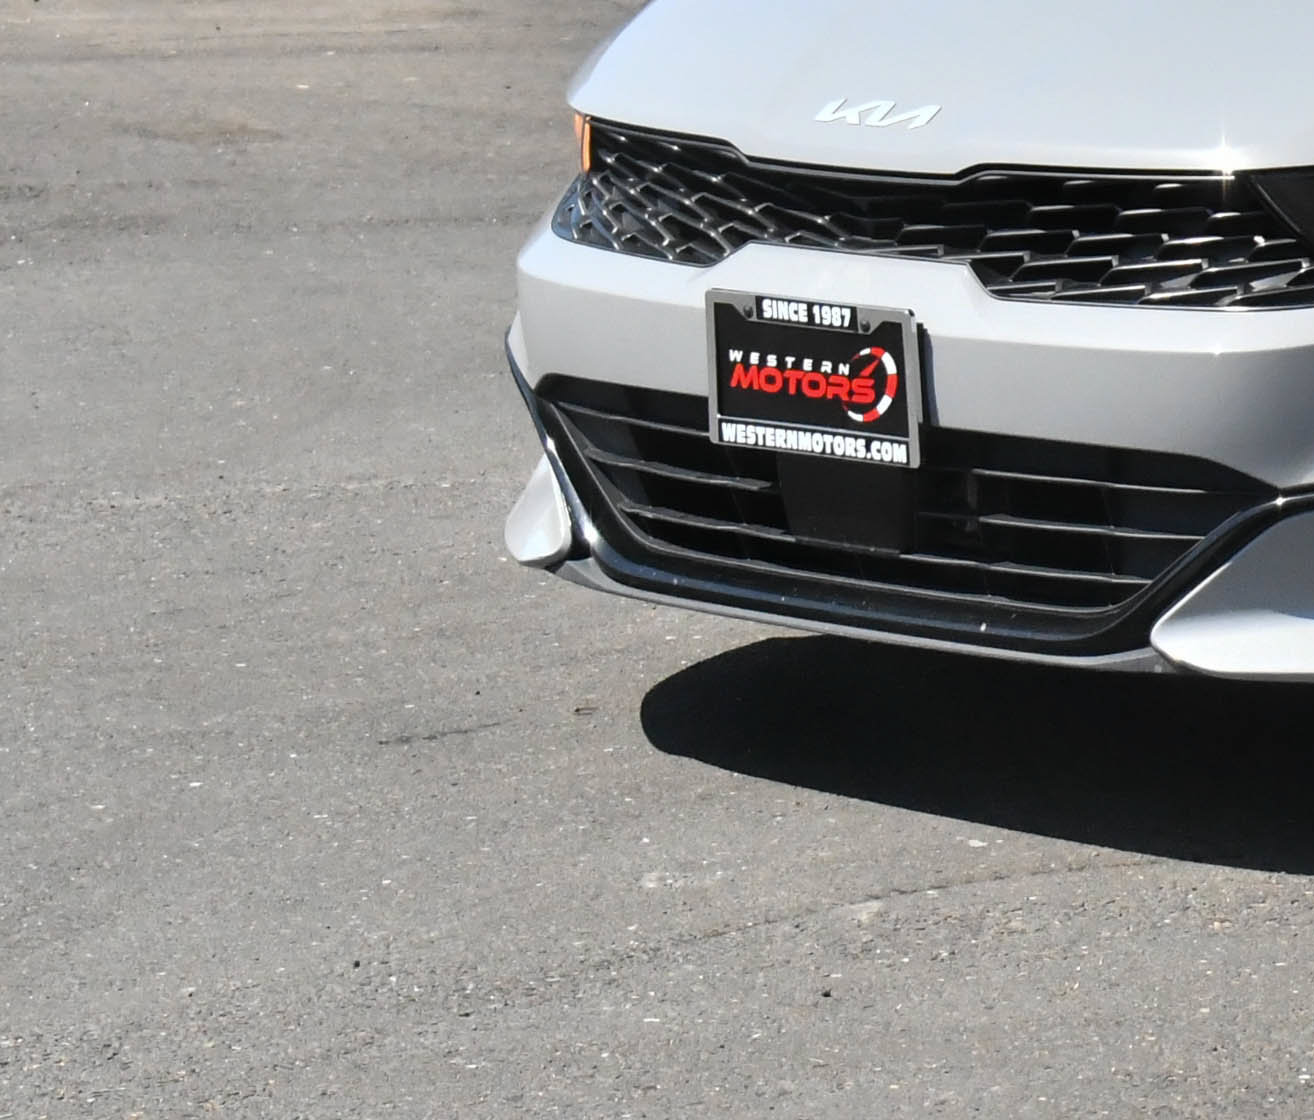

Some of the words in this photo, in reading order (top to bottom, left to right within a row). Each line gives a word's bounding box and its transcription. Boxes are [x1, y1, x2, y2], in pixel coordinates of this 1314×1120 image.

[762, 299, 808, 323] SINCE
[812, 305, 851, 328] 1987
[729, 349, 850, 376] WESTERN
[730, 363, 876, 404] MOTORS
[721, 423, 908, 464] WESTERNMOTORS.COM
